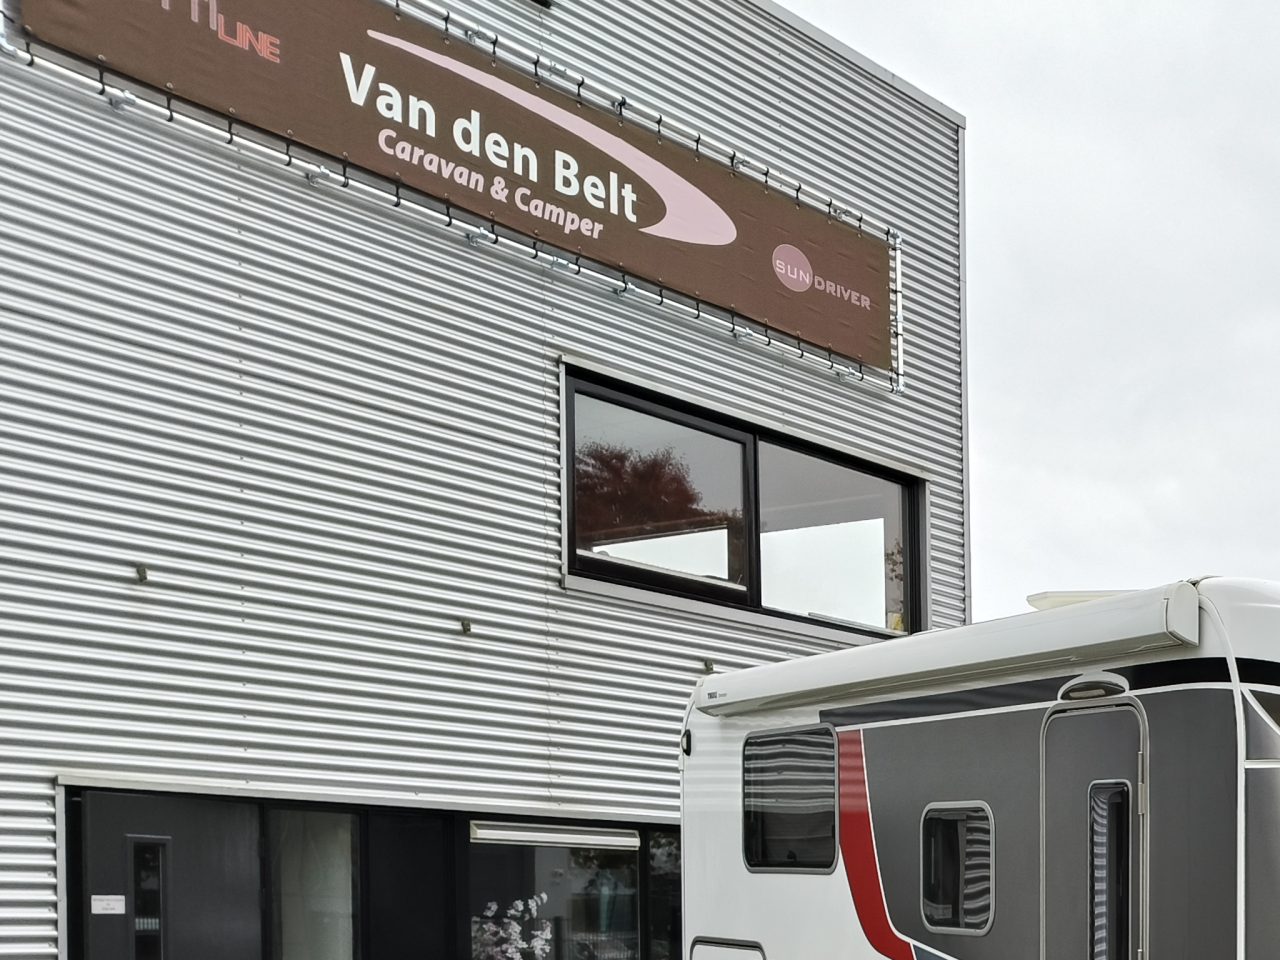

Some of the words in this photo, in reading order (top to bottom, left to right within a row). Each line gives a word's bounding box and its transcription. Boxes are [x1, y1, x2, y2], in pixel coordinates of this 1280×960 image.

[217, 13, 280, 64] LINE
[339, 51, 436, 138] Van
[452, 109, 538, 183] den
[554, 149, 637, 223] Belt
[377, 128, 485, 193] Caravan
[489, 175, 509, 204] &
[513, 186, 604, 240] Camper
[775, 259, 810, 285] SUN
[814, 275, 871, 311] DRIVER
